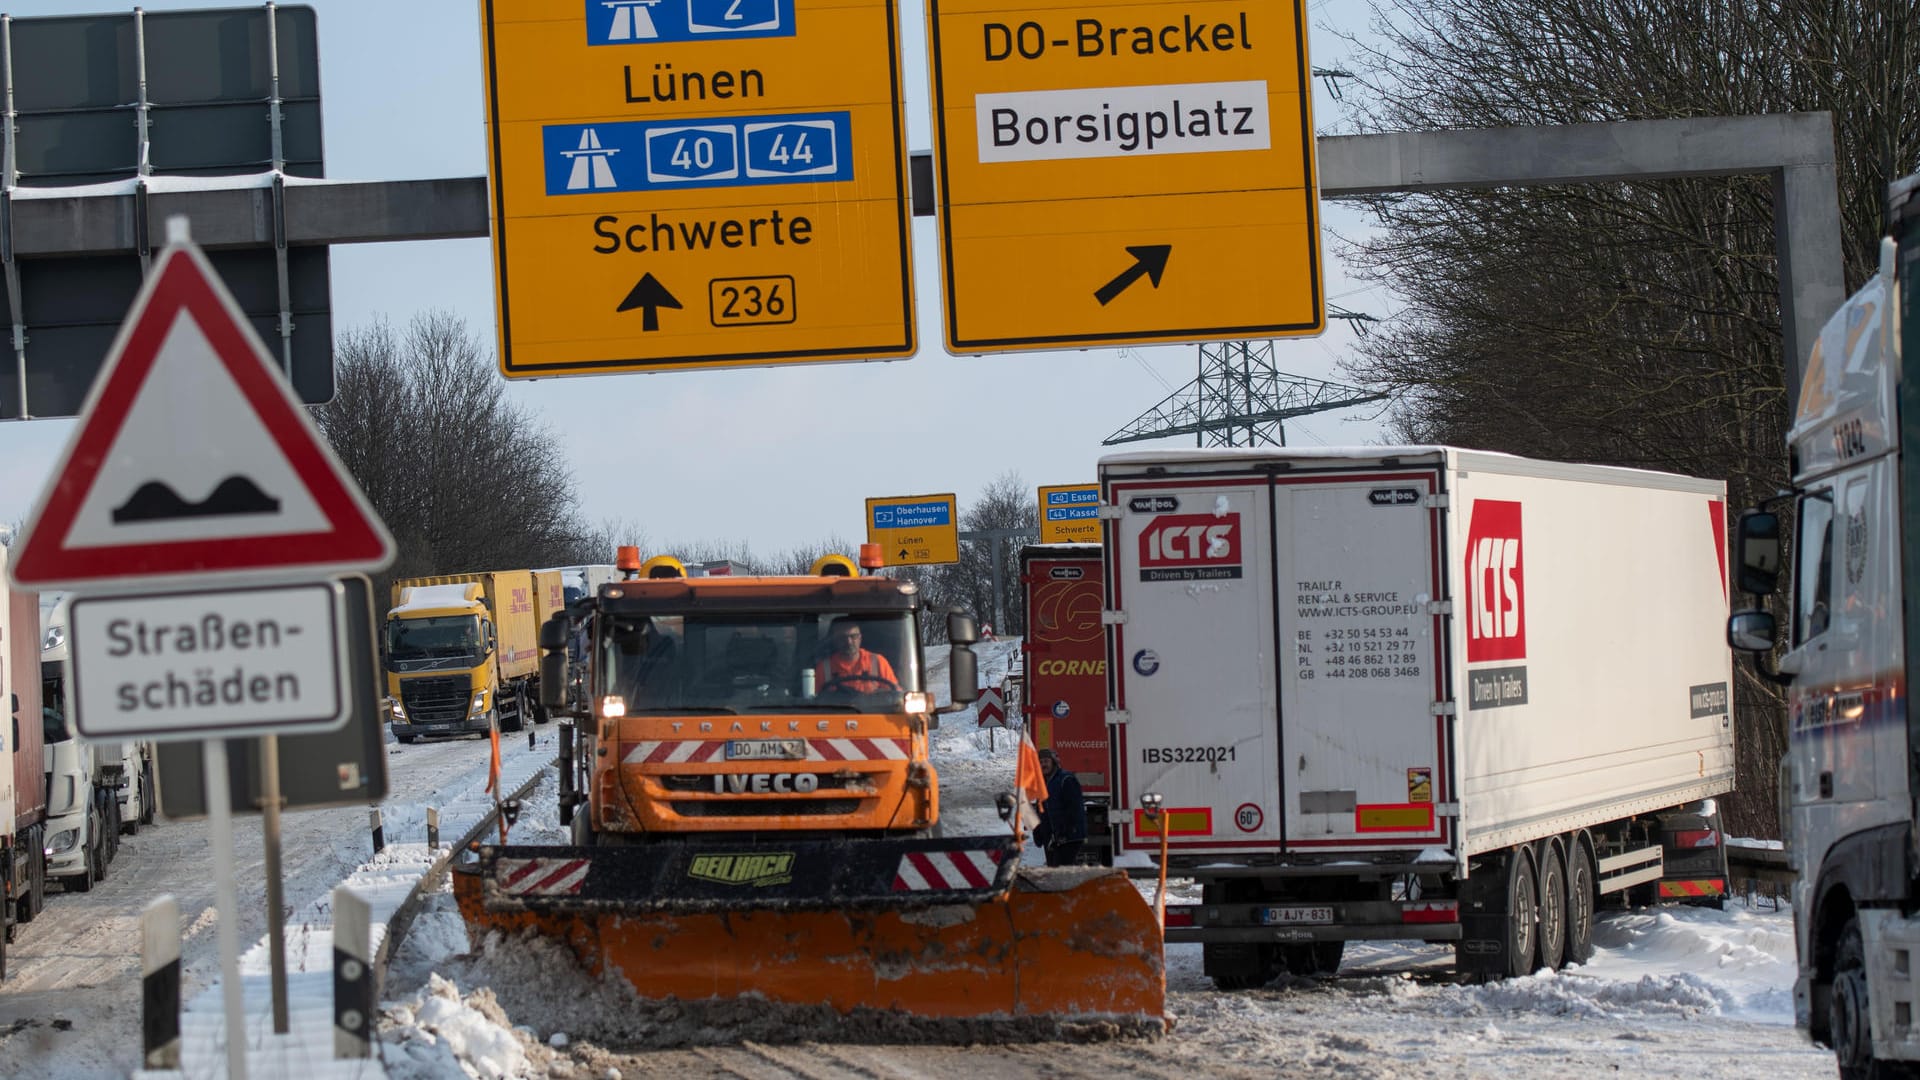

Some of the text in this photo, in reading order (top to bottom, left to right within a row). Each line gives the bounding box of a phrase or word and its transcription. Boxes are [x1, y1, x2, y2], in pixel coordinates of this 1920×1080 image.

[723, 0, 744, 21] 2
[984, 12, 1253, 62] DO-Brackel
[624, 63, 765, 104] Lünen
[991, 99, 1255, 152] Borsigplatz
[671, 136, 715, 170] 40
[768, 132, 814, 165] 44
[593, 210, 813, 254] Schwerte
[720, 284, 785, 318] 236
[1071, 493, 1098, 502] Essen
[896, 505, 948, 515] Oberhausen
[1070, 507, 1098, 517] Kassel
[896, 516, 937, 526] Hannover
[1055, 525, 1095, 534] Schwerte
[897, 535, 924, 545] Lünen
[1149, 524, 1233, 560] ICTS
[1150, 568, 1232, 581] Driven by Trailers
[1470, 537, 1519, 640] ICTS
[1343, 593, 1352, 603] &
[1354, 592, 1399, 603] SERVICE
[1298, 604, 1418, 618] WWW.ICTS-GROUP.EU
[106, 612, 305, 659] Straßen-
[1298, 630, 1312, 640] BE
[1347, 628, 1360, 638] 50
[1363, 628, 1376, 638] 54
[1379, 627, 1393, 638] 53
[1395, 627, 1409, 637] 44
[1298, 643, 1313, 653] NL
[1348, 642, 1361, 652] 10
[1363, 641, 1382, 651] 521
[1386, 641, 1400, 651] 29
[1402, 640, 1416, 650] 77
[1299, 656, 1311, 666] PL
[1325, 655, 1345, 665] +48
[1363, 654, 1384, 664] 862
[1387, 654, 1400, 664] 12
[1402, 653, 1416, 663] 89
[1038, 660, 1106, 676] CORNE
[1299, 666, 1420, 680] GB +44 208 068 3468
[116, 667, 301, 713] schäden
[671, 719, 859, 732] TRAKKER
[735, 743, 752, 756] DO
[760, 742, 777, 755] AM
[1142, 745, 1236, 764] IBS322021
[713, 772, 819, 794] IVECO
[1240, 810, 1253, 825] 60
[691, 854, 792, 881] BEILHACK
